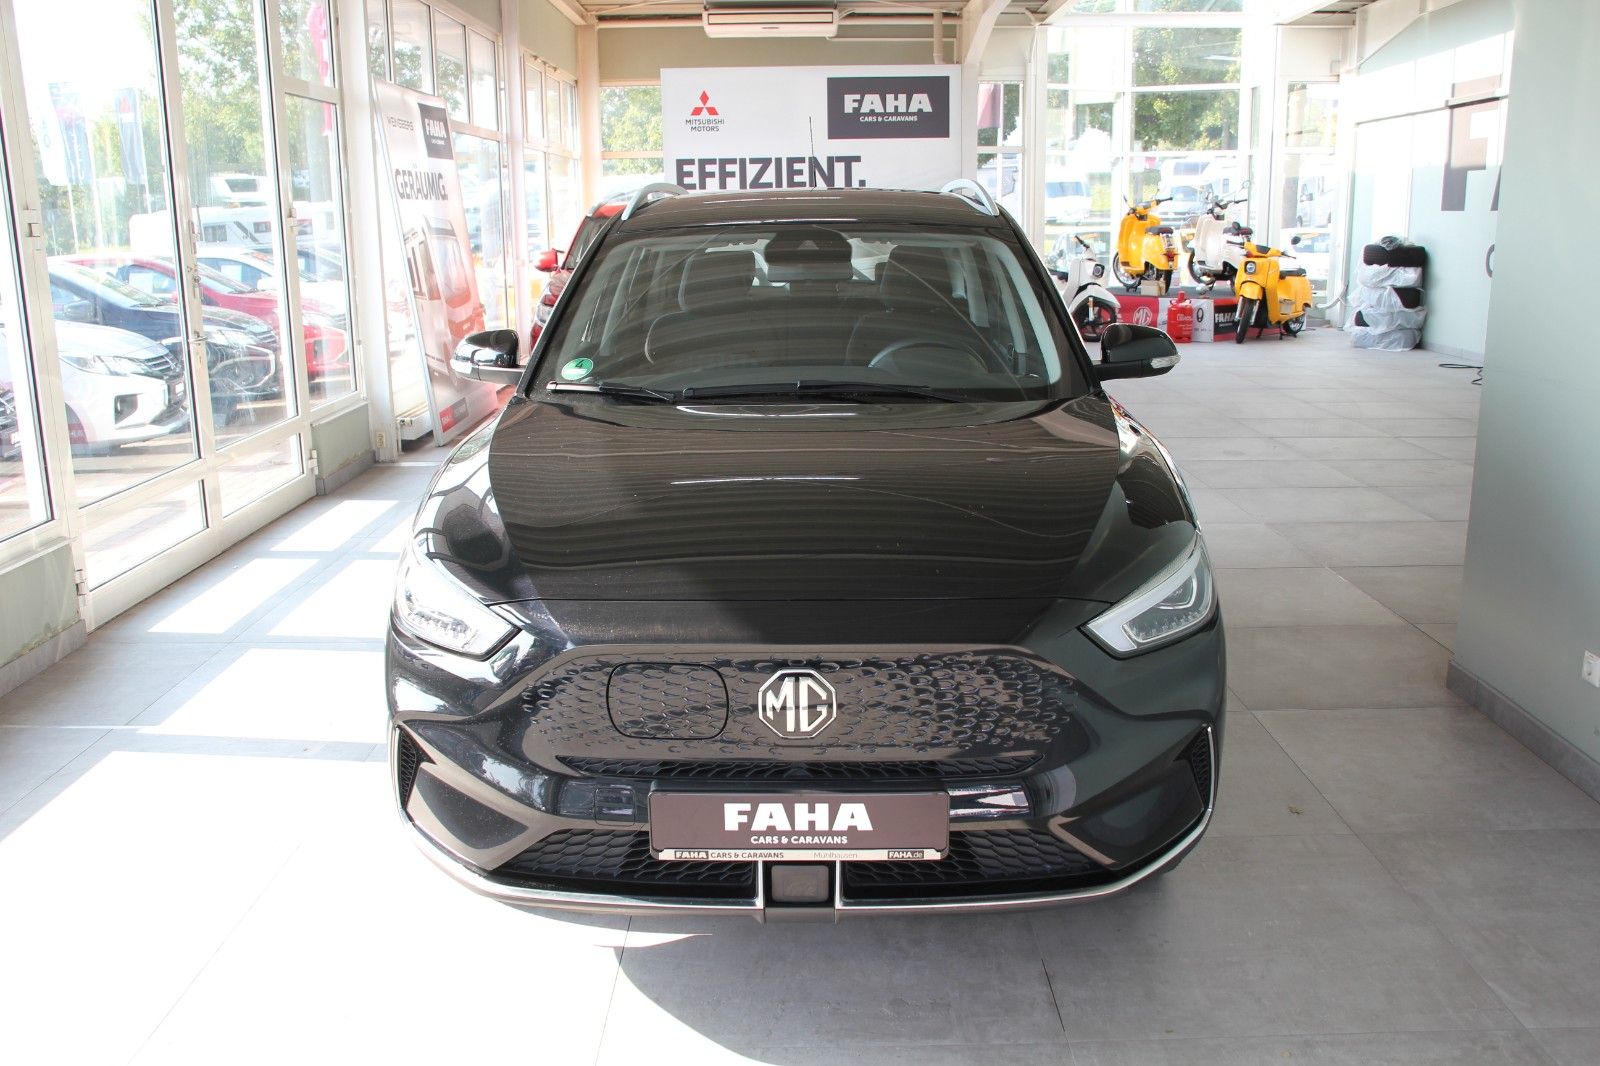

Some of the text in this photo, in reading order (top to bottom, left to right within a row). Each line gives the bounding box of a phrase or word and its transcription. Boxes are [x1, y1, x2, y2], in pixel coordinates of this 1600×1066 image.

[844, 93, 933, 114] FAHA
[425, 118, 447, 138] FAHA
[685, 118, 725, 126] MITSUBISHI
[859, 115, 877, 123] CARS
[877, 115, 883, 123] &
[675, 155, 867, 190] EFFIZIENT.
[1134, 307, 1152, 326] MG
[765, 675, 829, 733] MG
[723, 802, 874, 831] FAHA
[750, 835, 848, 845] CARS & CARAVANS
[675, 851, 708, 859] FAHA
[888, 851, 923, 859] FAHA.de
